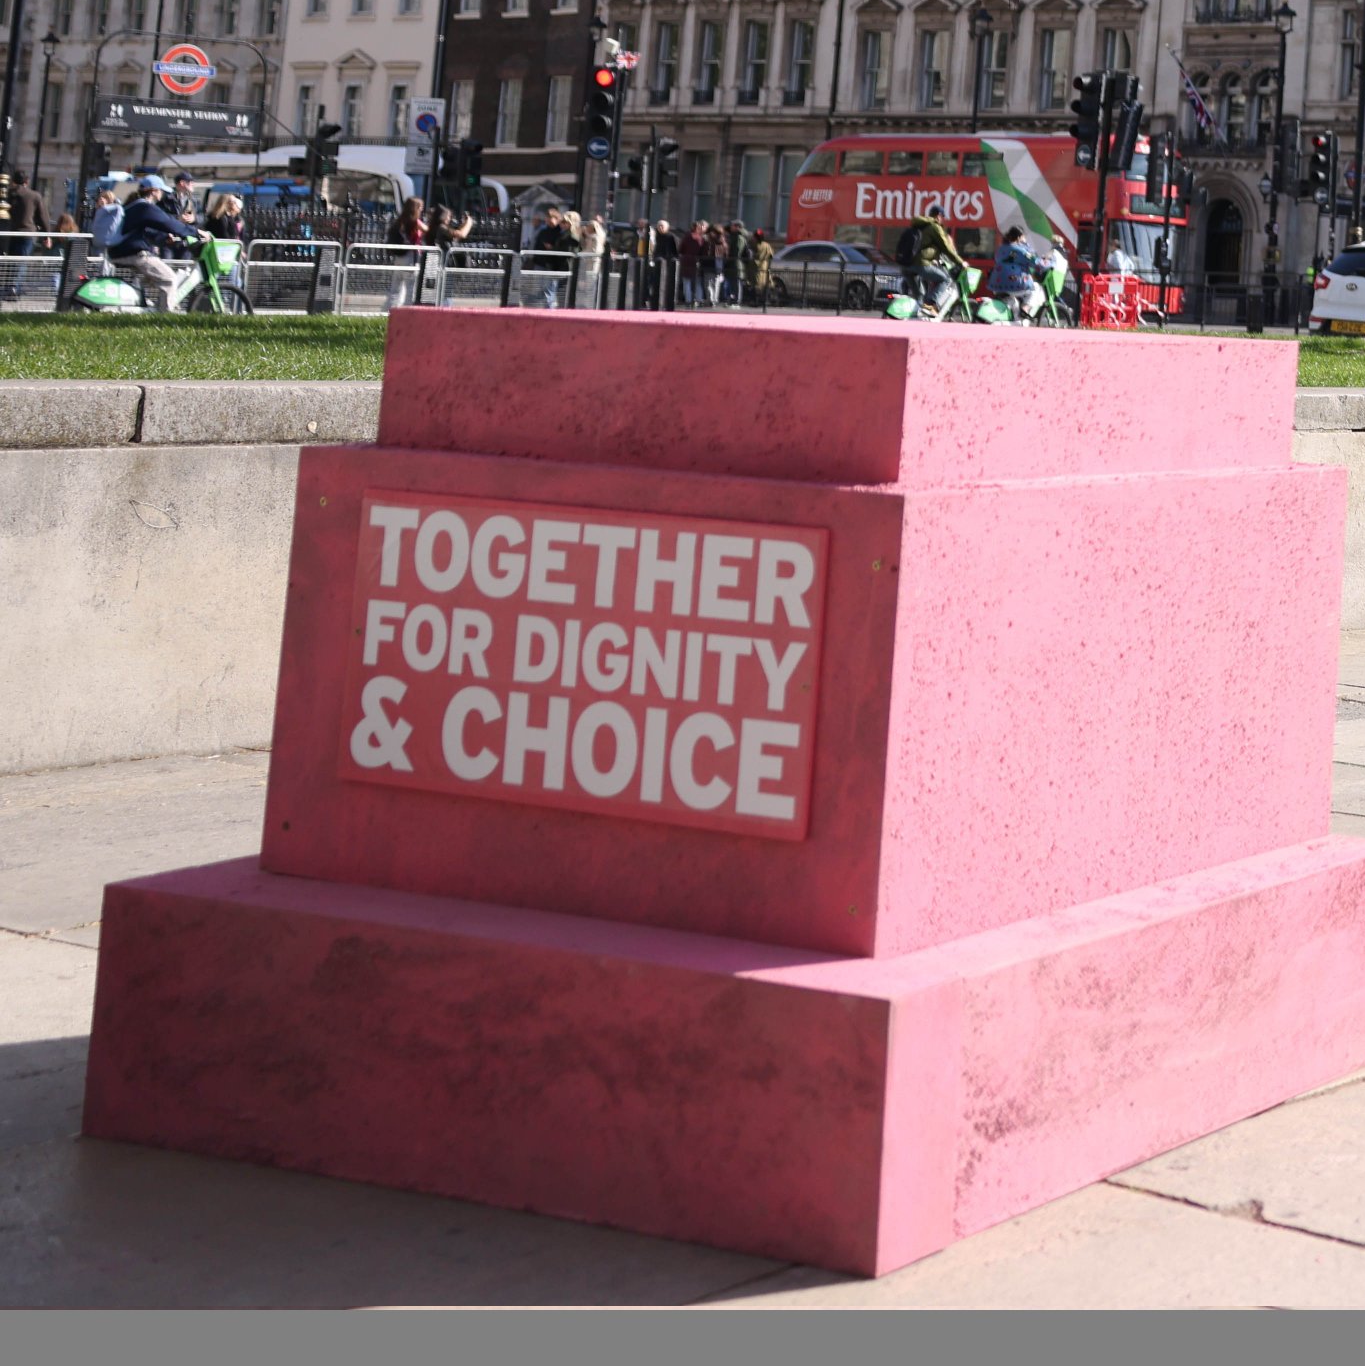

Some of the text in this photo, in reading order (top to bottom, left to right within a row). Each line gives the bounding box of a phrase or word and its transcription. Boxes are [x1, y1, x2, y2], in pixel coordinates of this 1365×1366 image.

[132, 105, 228, 121] WESTMINSTER STATION
[855, 181, 984, 221] Emirates
[370, 505, 815, 628] TOGETHER
[363, 600, 807, 711] FOR DIGNITY
[350, 676, 800, 820] & CHOICE
